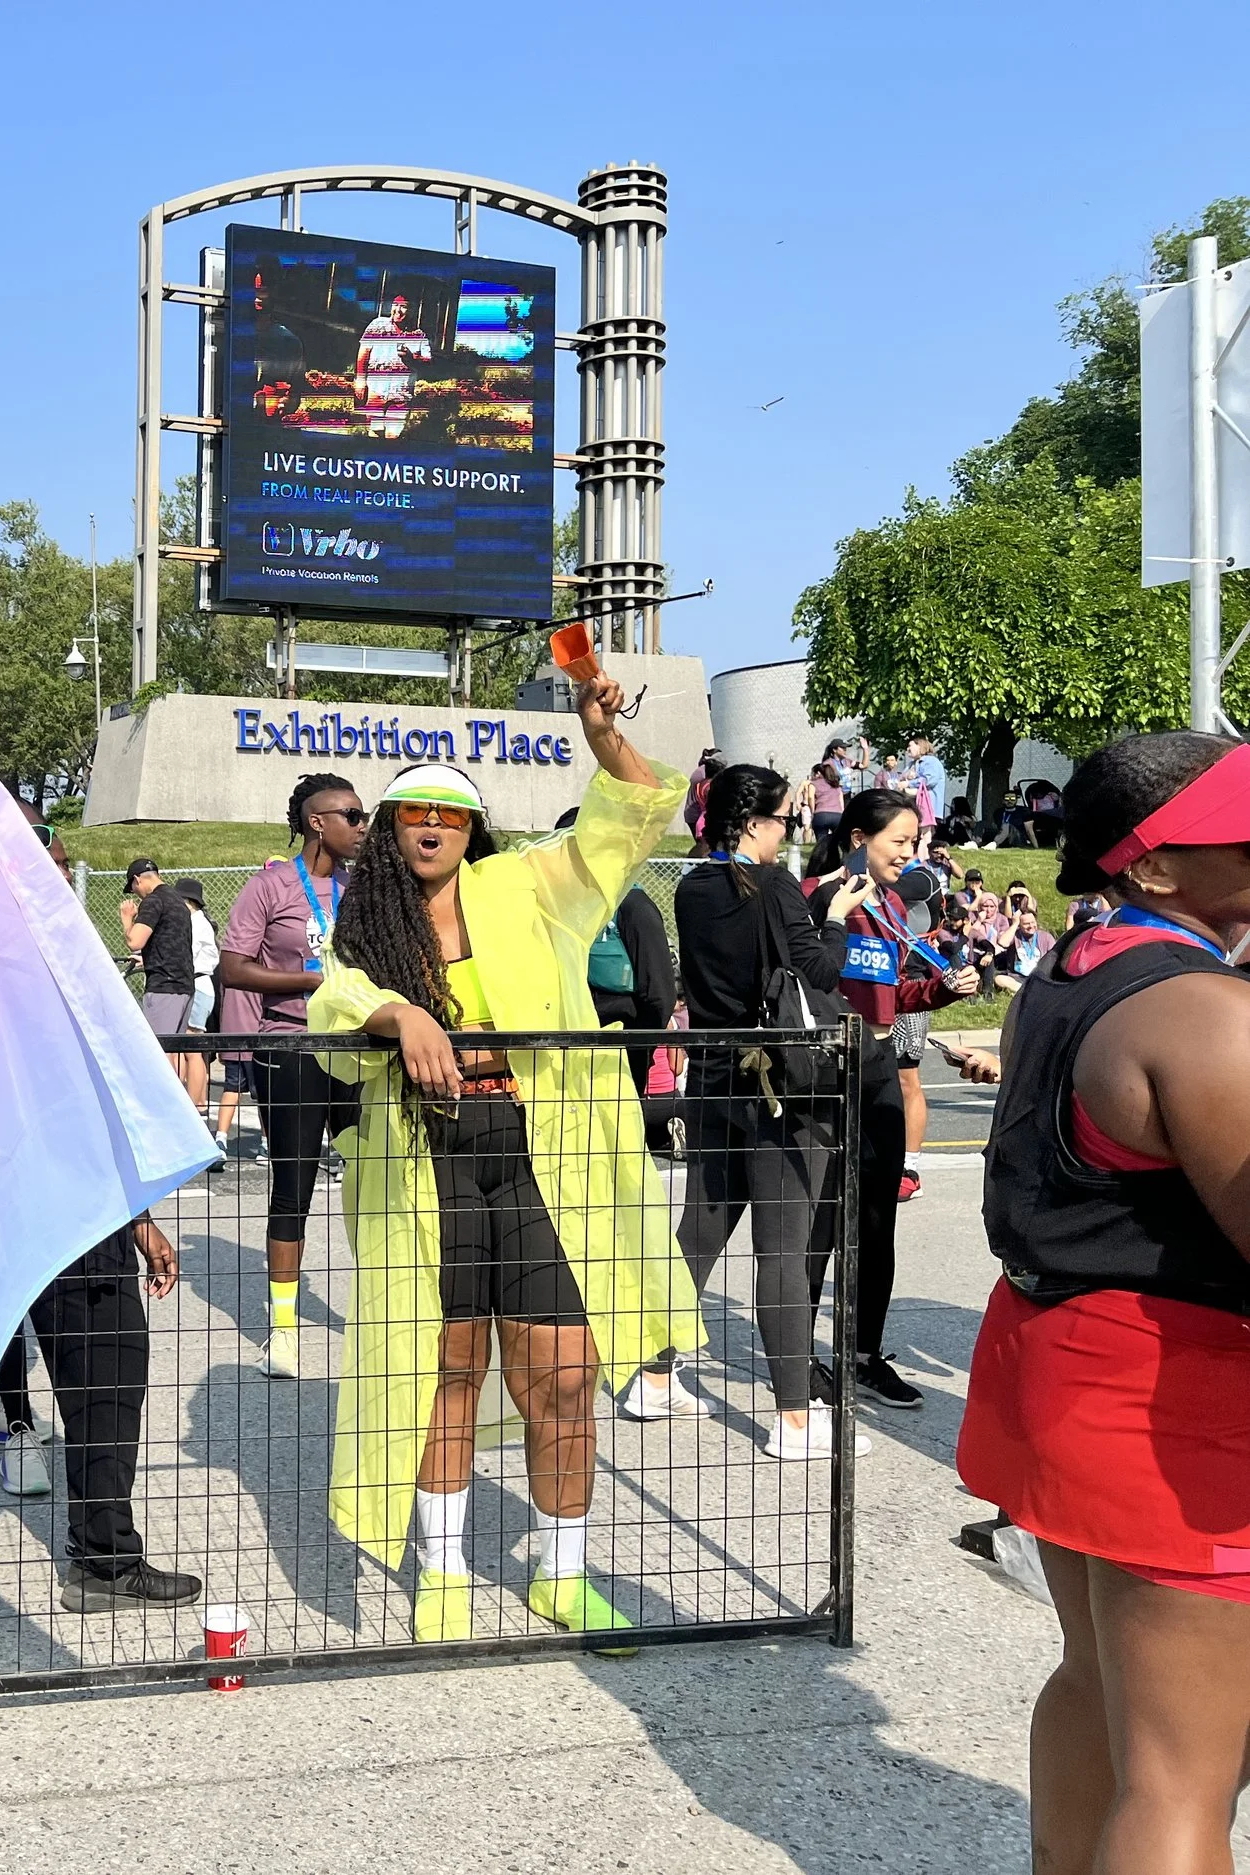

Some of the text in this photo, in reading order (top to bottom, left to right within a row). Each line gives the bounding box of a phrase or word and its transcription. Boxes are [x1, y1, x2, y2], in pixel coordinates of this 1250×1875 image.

[263, 452, 525, 494] LIVE CUSTOMER SUPPORT.
[261, 482, 415, 509] FROM REAL PEOPLE.
[299, 527, 383, 560] Vrbo
[261, 566, 379, 584] Private Vacation Rentals
[234, 708, 574, 763] Exhibition Place
[848, 947, 890, 970] 5092
